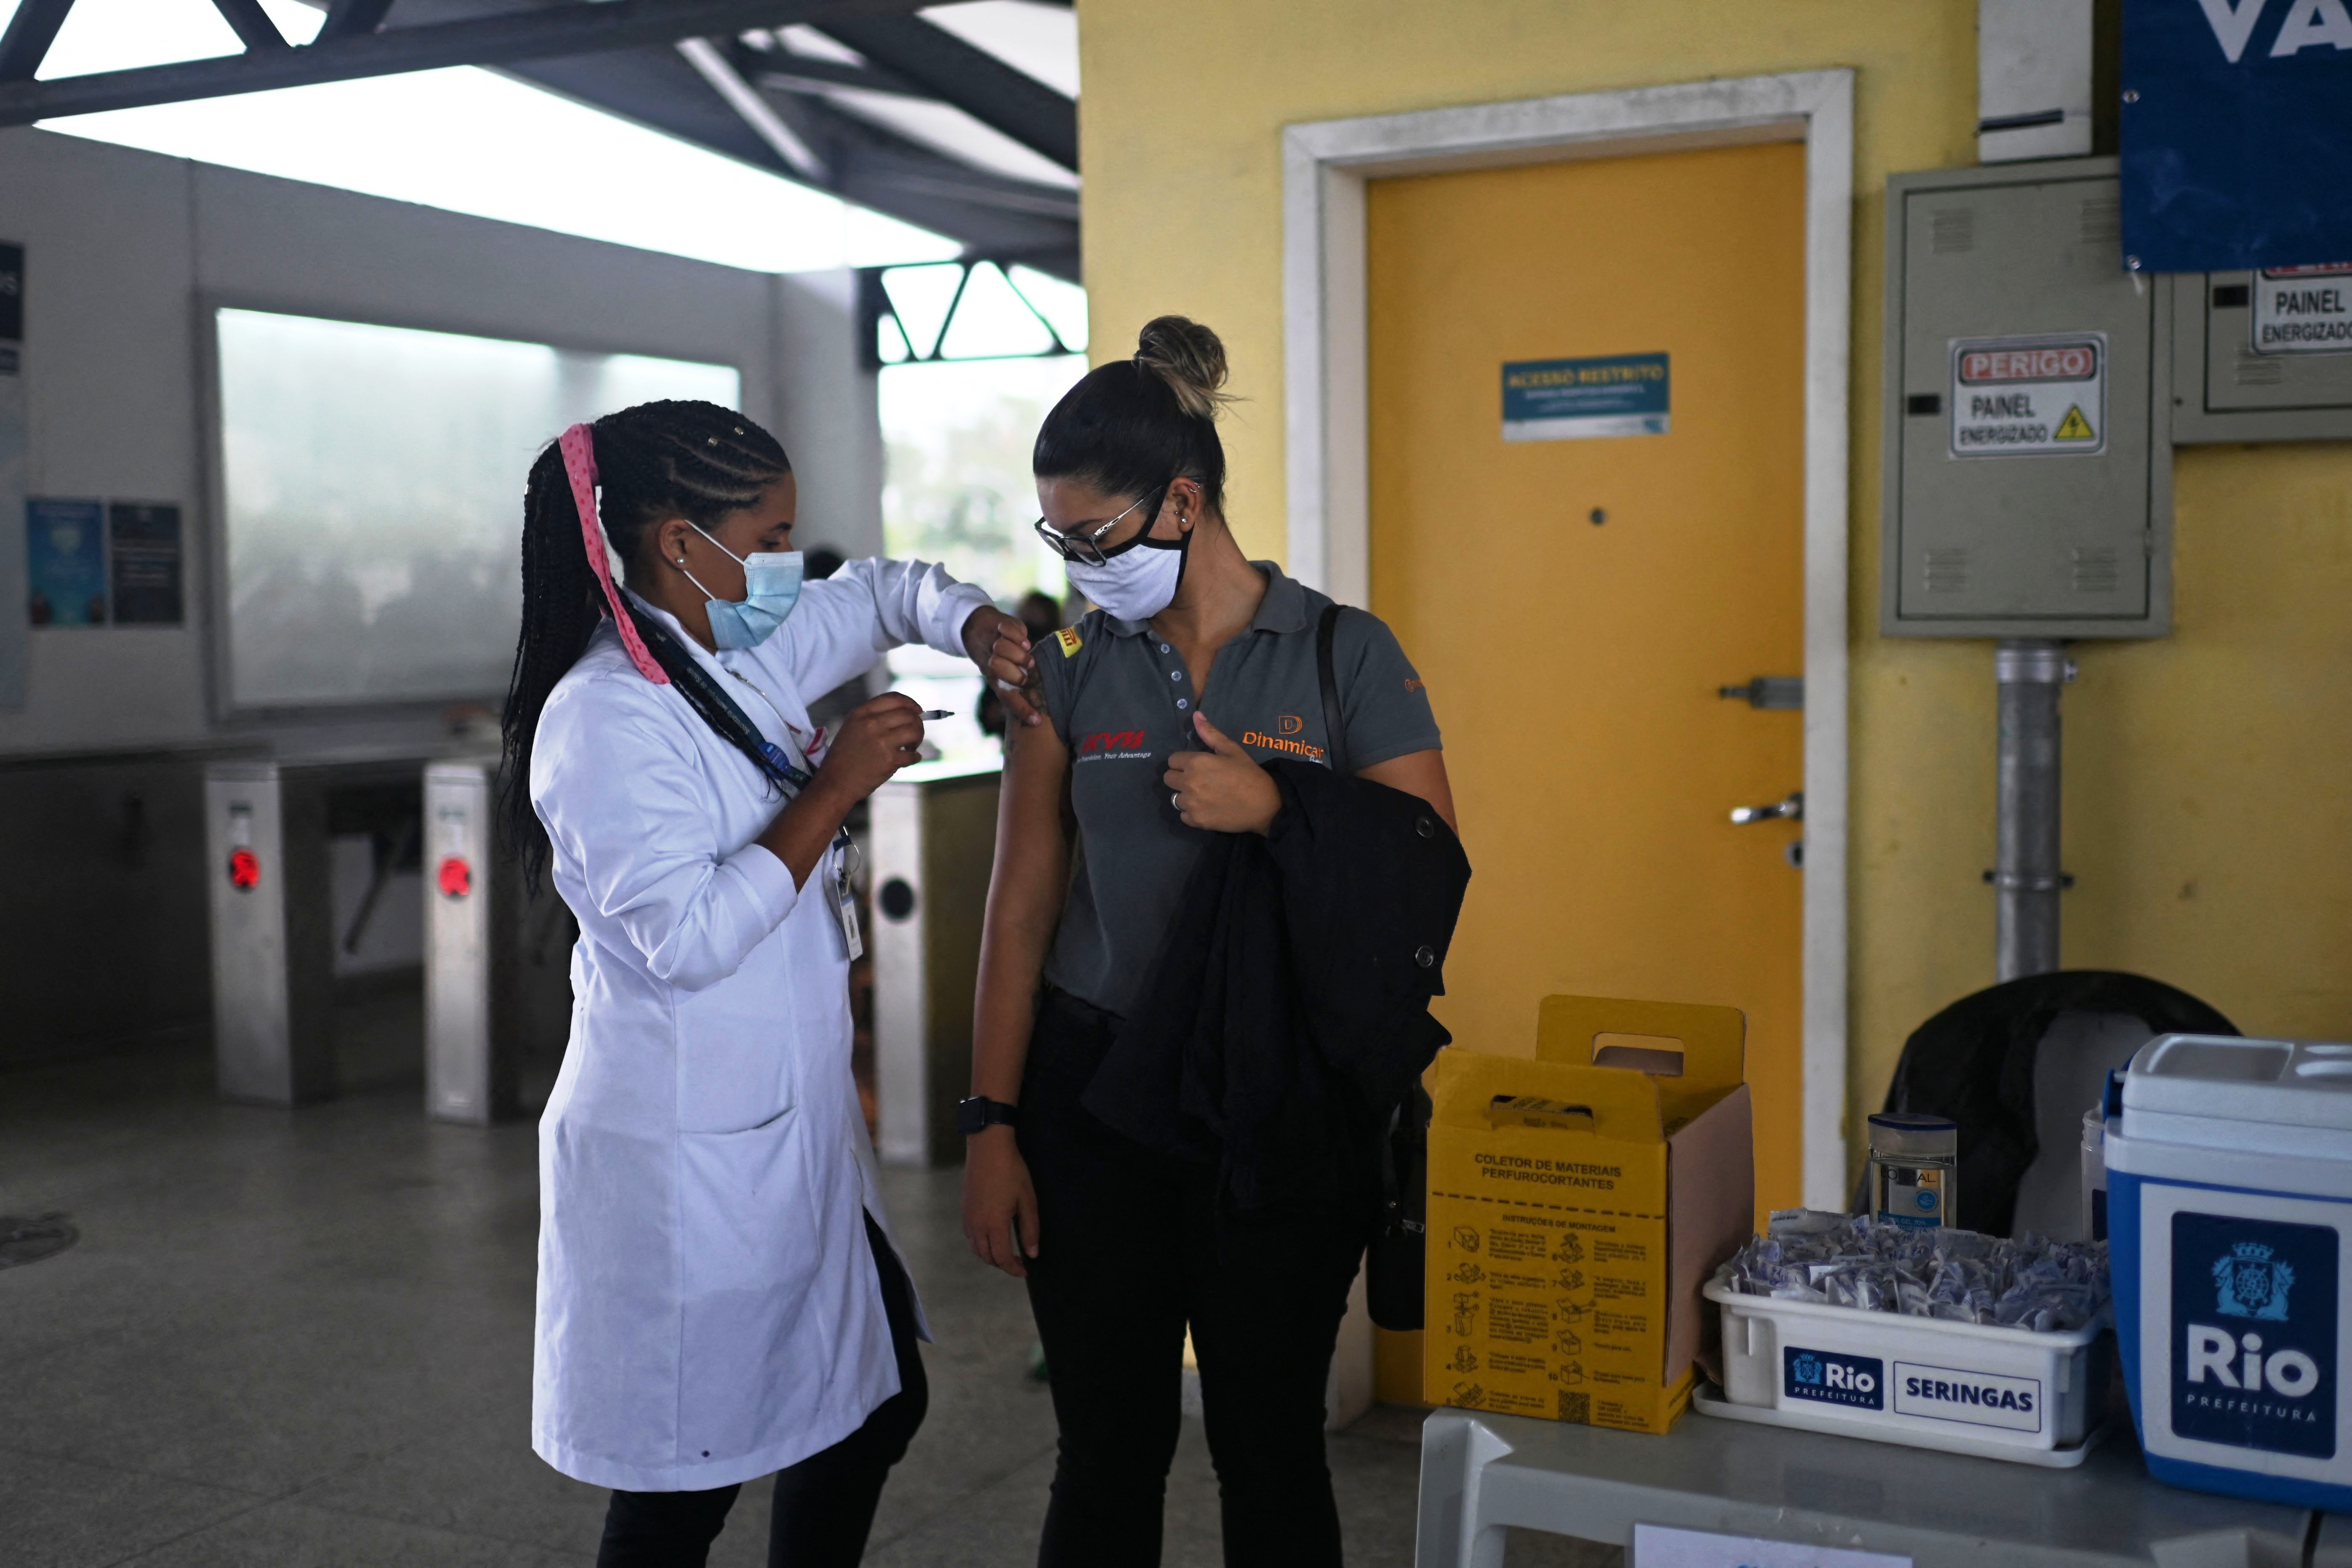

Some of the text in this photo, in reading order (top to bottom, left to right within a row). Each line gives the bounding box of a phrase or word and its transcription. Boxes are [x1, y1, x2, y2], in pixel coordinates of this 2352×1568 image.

[2276, 289, 2345, 314] PAINEL
[1971, 349, 2086, 378] PERIGO
[1972, 395, 2035, 419] PAINEL
[1960, 423, 2048, 445] ENERGIZADO
[1475, 1153, 1622, 1177] COLETOR DE MATERIAIS
[1482, 1168, 1614, 1190] PERFUROCORTANTES
[1503, 1214, 1553, 1227] INSTRUÇÕES
[1569, 1222, 1616, 1233] MONTAGEM
[2187, 1323, 2319, 1397] Rio
[1548, 1373, 1558, 1381] 10
[1826, 1363, 1875, 1392] Rio
[1795, 1387, 1874, 1405] PREFEITURA
[1907, 1377, 2033, 1412] SERINGAS
[2187, 1395, 2315, 1422] PREFEITURA
